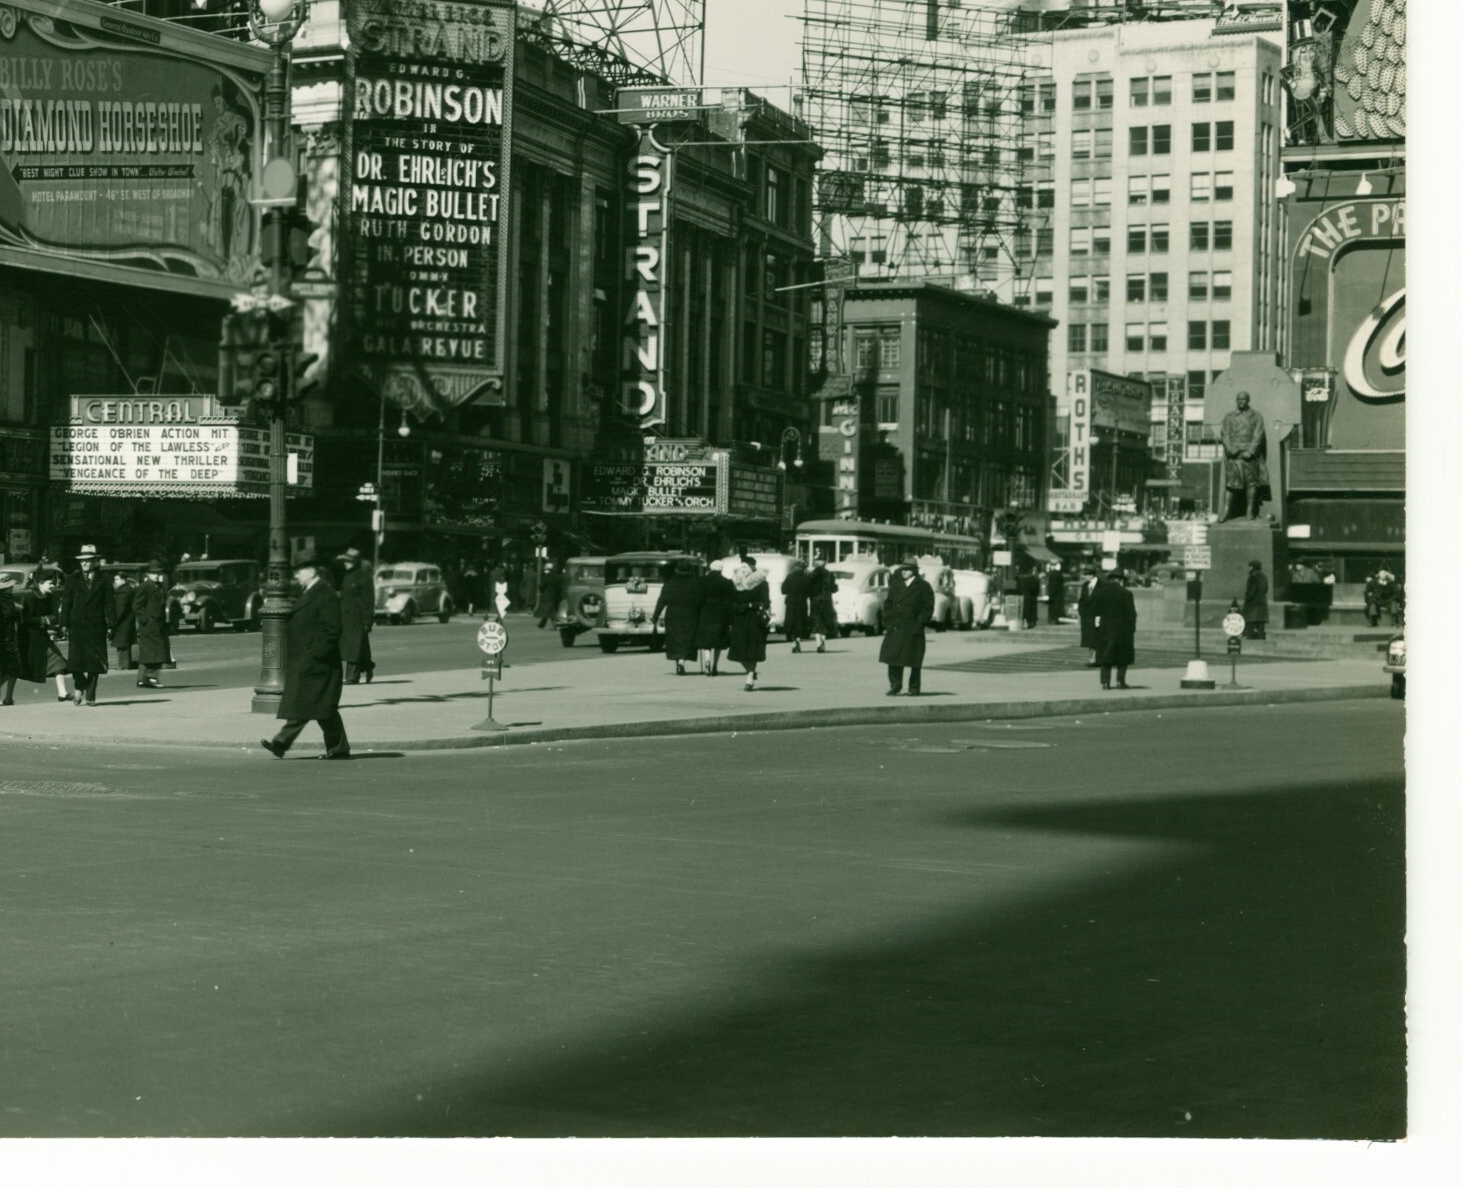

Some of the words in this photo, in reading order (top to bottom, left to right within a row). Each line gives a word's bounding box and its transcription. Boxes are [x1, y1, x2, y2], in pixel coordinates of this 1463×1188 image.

[363, 19, 507, 66] STRAND
[61, 57, 123, 93] ROSE'S
[389, 62, 450, 78] EDWARD
[455, 68, 471, 81] G.
[354, 76, 504, 126] ROBINSON
[640, 94, 697, 108] WARNER
[0, 98, 93, 155] DIAMOND
[98, 100, 204, 156] HORSESHOE
[423, 123, 437, 134] IN
[384, 136, 407, 149] THE
[412, 139, 452, 152] STORY
[459, 142, 476, 154] OF
[43, 167, 64, 178] NIGHT
[89, 167, 108, 177] SHOW
[356, 150, 388, 181] DR.
[398, 153, 497, 190] EHRLICH'S
[351, 183, 418, 217] MAGIC
[426, 188, 500, 222] BULLET
[360, 218, 408, 239] RUTH
[419, 220, 492, 246] GORDON
[1299, 205, 1362, 258] THE
[403, 245, 469, 269] PERSON
[622, 154, 664, 418] STRAND
[374, 282, 478, 319] TUCKER
[409, 319, 487, 335] ORCHESTRA
[363, 334, 412, 355] GALA
[420, 336, 486, 359] REVUE
[86, 399, 197, 425] CENTRAL
[55, 428, 98, 439] GEORGE
[109, 428, 150, 439] O'BRIEN
[161, 428, 200, 439] ACTION
[211, 428, 228, 439] HIT
[1073, 373, 1087, 491] ROTHS
[110, 441, 123, 453] OF
[132, 441, 152, 453] THE
[53, 454, 127, 467] SENSATIONAL
[136, 454, 161, 467] NEW
[174, 454, 229, 467] THRILLER
[135, 468, 149, 479] OF
[158, 468, 178, 479] THE
[594, 466, 636, 476] EDWARD
[655, 465, 706, 477] ROBINSON
[653, 476, 702, 487] EHRLICH'S
[611, 486, 642, 497] MAGIC
[599, 496, 633, 507] TOMMY
[637, 496, 674, 507] TUCKER
[1055, 502, 1078, 511] BAR
[480, 624, 504, 636] BUS
[478, 638, 504, 651] STOP
